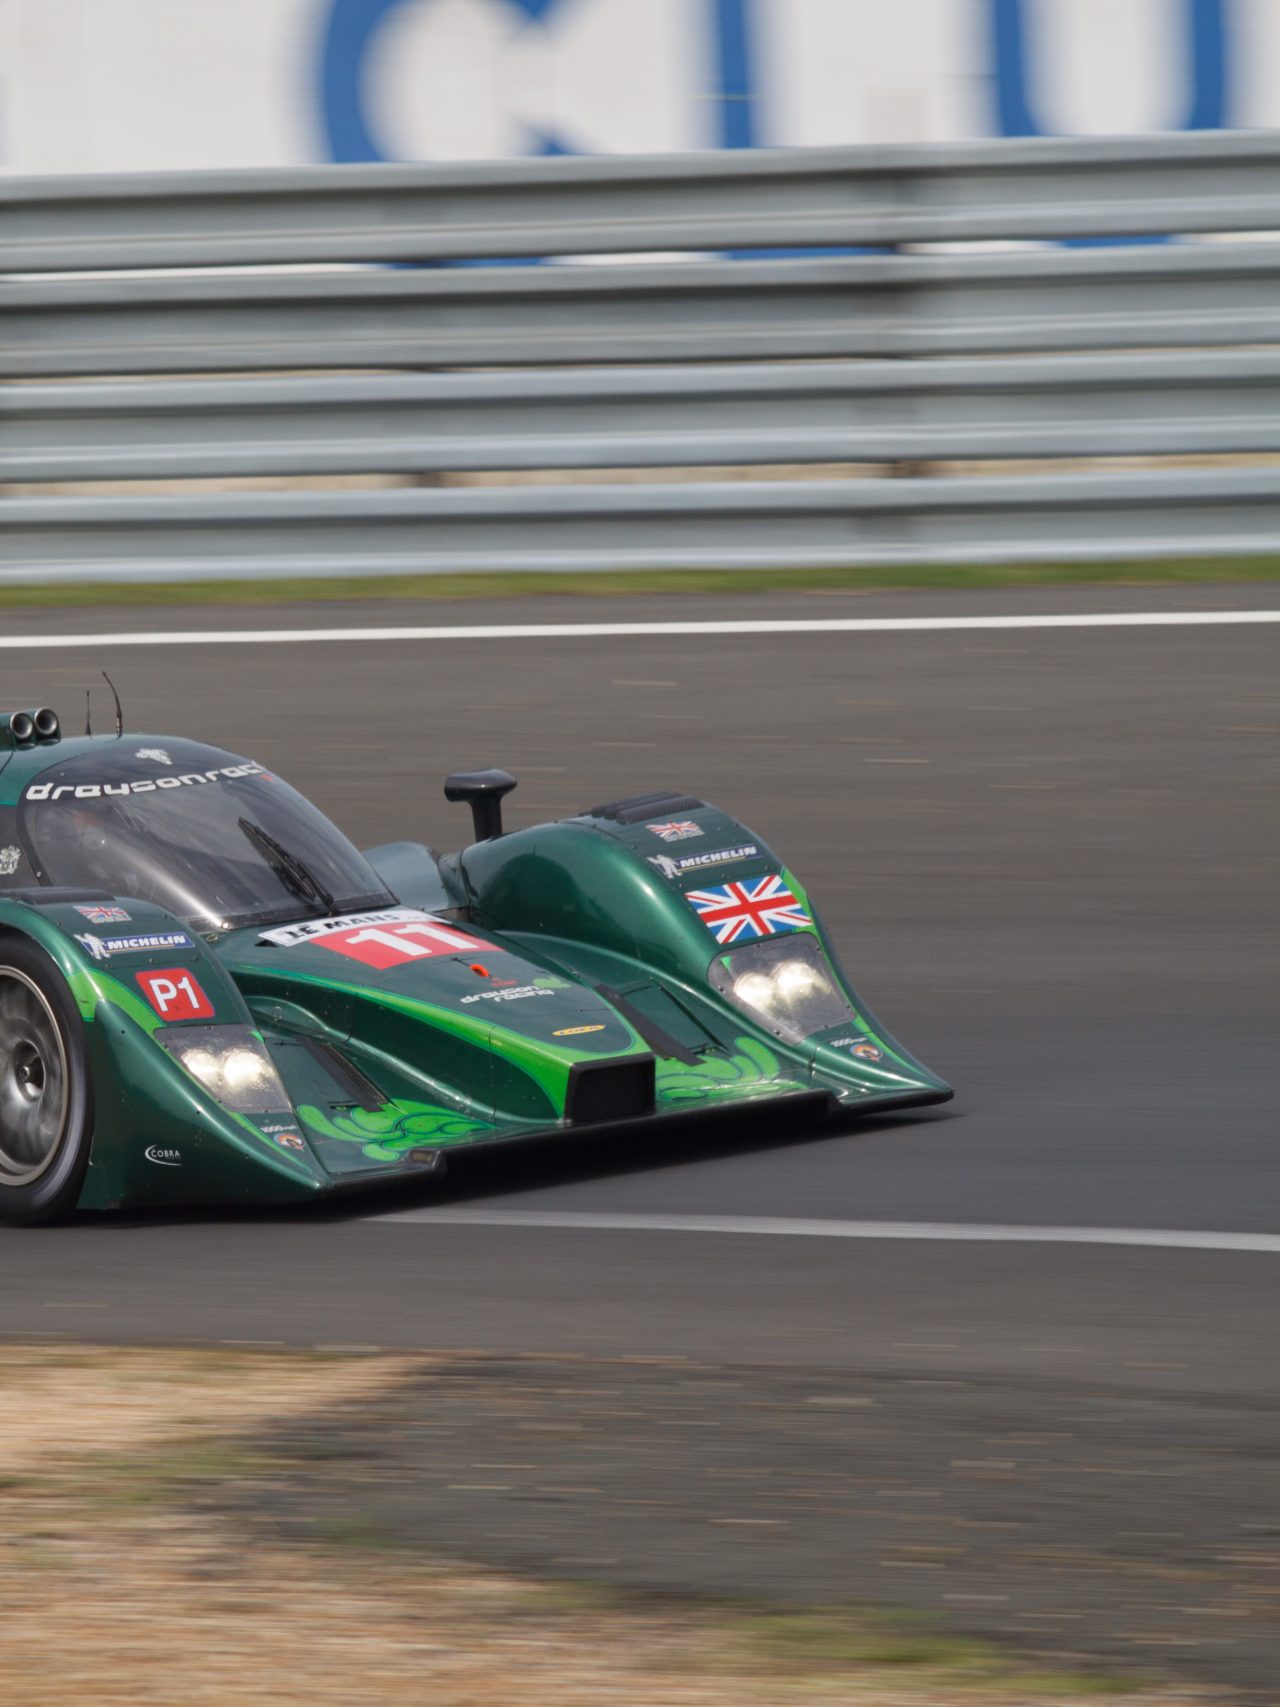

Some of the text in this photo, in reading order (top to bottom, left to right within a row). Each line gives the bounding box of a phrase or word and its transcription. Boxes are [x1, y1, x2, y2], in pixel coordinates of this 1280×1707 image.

[679, 846, 757, 868] MICHELIN
[323, 913, 402, 930] MANS
[106, 935, 186, 950] MICHELIN
[345, 923, 480, 957] 11
[148, 976, 200, 1012] P1
[150, 1149, 181, 1159] COBRA
